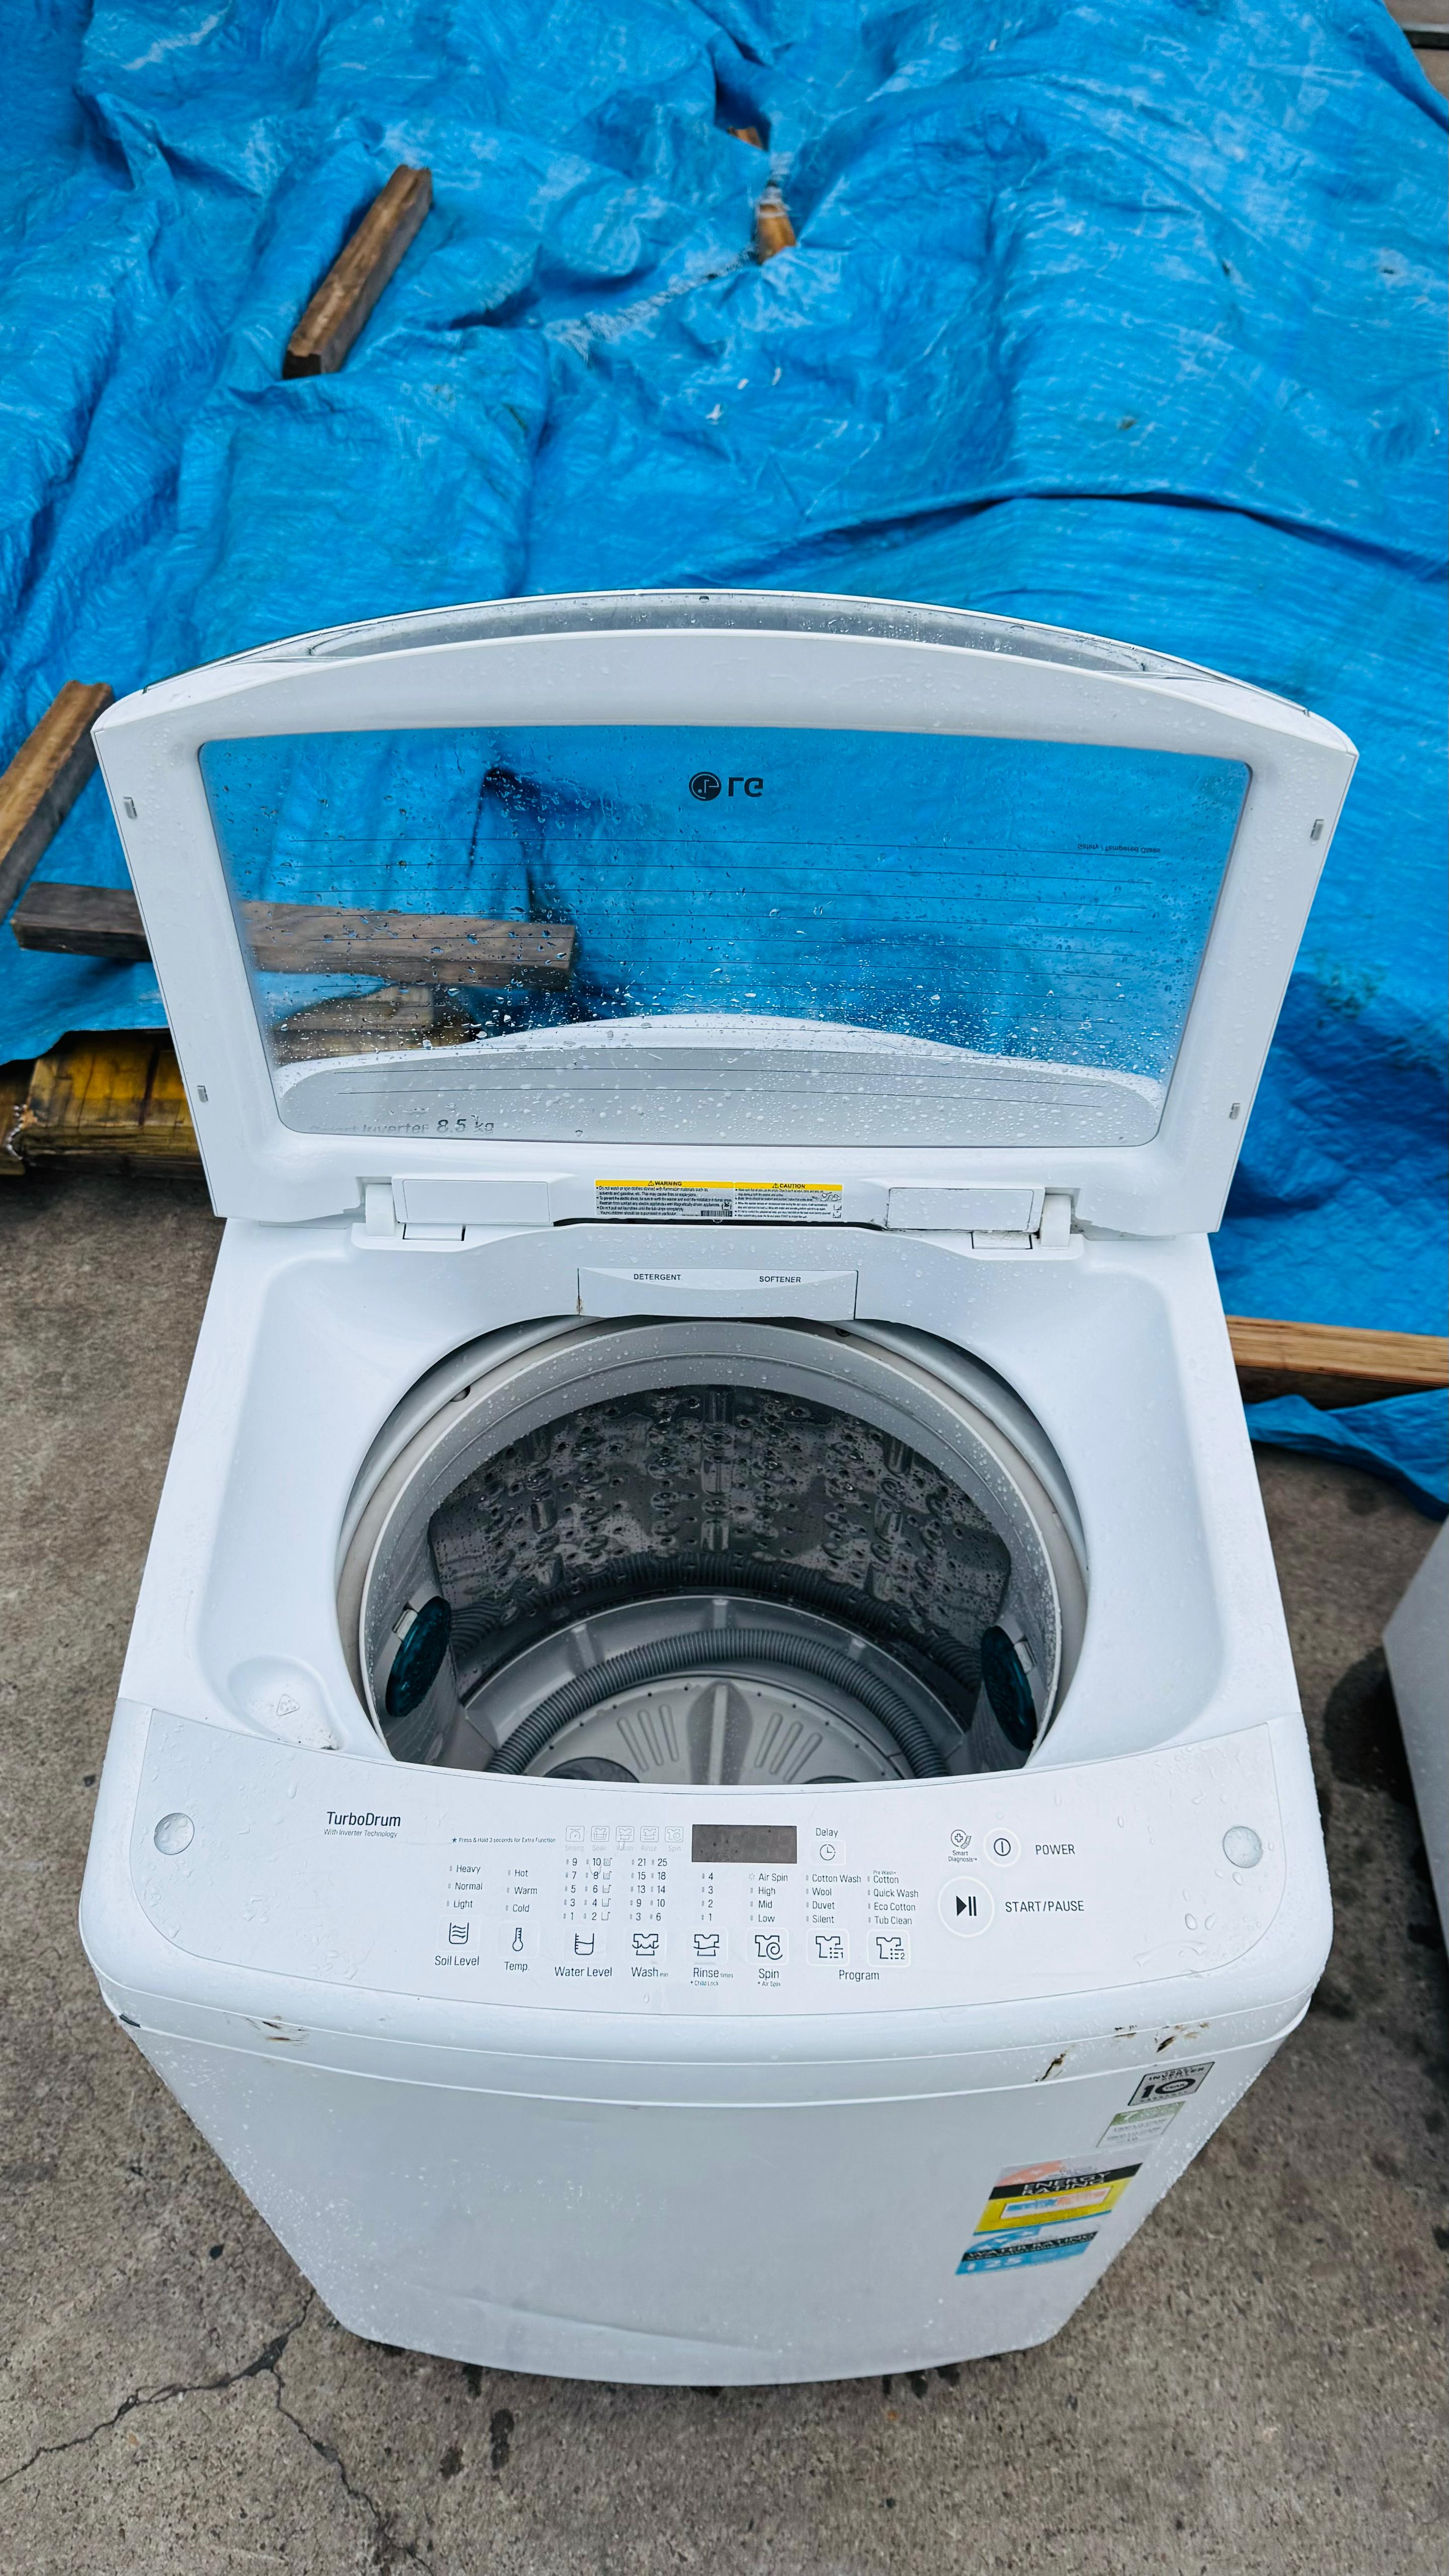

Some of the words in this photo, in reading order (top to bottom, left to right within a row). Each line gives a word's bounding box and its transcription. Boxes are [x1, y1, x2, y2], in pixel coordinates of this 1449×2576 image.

[437, 1119, 467, 1133] 8.5
[327, 1812, 400, 1826] TurboDrum
[364, 1830, 398, 1838] Technology
[816, 1828, 838, 1837] Delay
[1036, 1844, 1075, 1855] POWER
[572, 1858, 578, 1866] 9
[593, 1858, 602, 1866] 10
[637, 1858, 646, 1867] 21
[658, 1858, 668, 1867] 25
[456, 1865, 480, 1874] Heavy
[572, 1871, 577, 1880] 7
[593, 1871, 599, 1880] 8
[637, 1872, 646, 1880] 15
[658, 1872, 666, 1880] 18
[708, 1872, 713, 1880] 4
[772, 1874, 787, 1883] Spin
[812, 1874, 837, 1883] Cotton
[839, 1874, 861, 1883] Wash
[873, 1875, 899, 1884] Cotton
[571, 1885, 576, 1893] 5
[593, 1885, 598, 1893] 6
[637, 1885, 646, 1893] 13
[657, 1885, 666, 1893] 14
[708, 1886, 713, 1894] 3
[759, 1887, 775, 1896] High
[812, 1887, 832, 1896] Wool
[873, 1889, 895, 1897] Quick
[897, 1889, 919, 1898] Wash
[454, 1900, 472, 1909] Light
[570, 1898, 576, 1907] 3
[592, 1898, 597, 1907] 4
[636, 1899, 641, 1907] 9
[657, 1899, 665, 1907] 10
[708, 1899, 713, 1908] 2
[813, 1901, 835, 1910] Duvet
[874, 1902, 888, 1911] Eco
[890, 1902, 916, 1911] Cotton
[1006, 1901, 1084, 1912] START/PAUSE
[571, 1912, 574, 1920] 1
[592, 1912, 597, 1920] 2
[636, 1912, 641, 1921] 3
[656, 1912, 661, 1921] 6
[812, 1914, 835, 1923] Silent
[874, 1916, 889, 1924] Tub
[891, 1916, 912, 1925] Clean
[435, 1956, 451, 1965] Soil
[455, 1956, 479, 1965] Level
[504, 1961, 530, 1972] Temp.
[555, 1967, 584, 1976] Water
[588, 1967, 612, 1976] Level
[631, 1967, 658, 1977] Wash
[693, 1968, 719, 1978] Rinse
[759, 1968, 779, 1980] Spin
[839, 1970, 879, 1982] Program
[1149, 2067, 1204, 2081] INVERTER
[1141, 2078, 1196, 2099] 10
[1024, 2171, 1111, 2190] ENERGY
[1022, 2179, 1105, 2196] RATING
